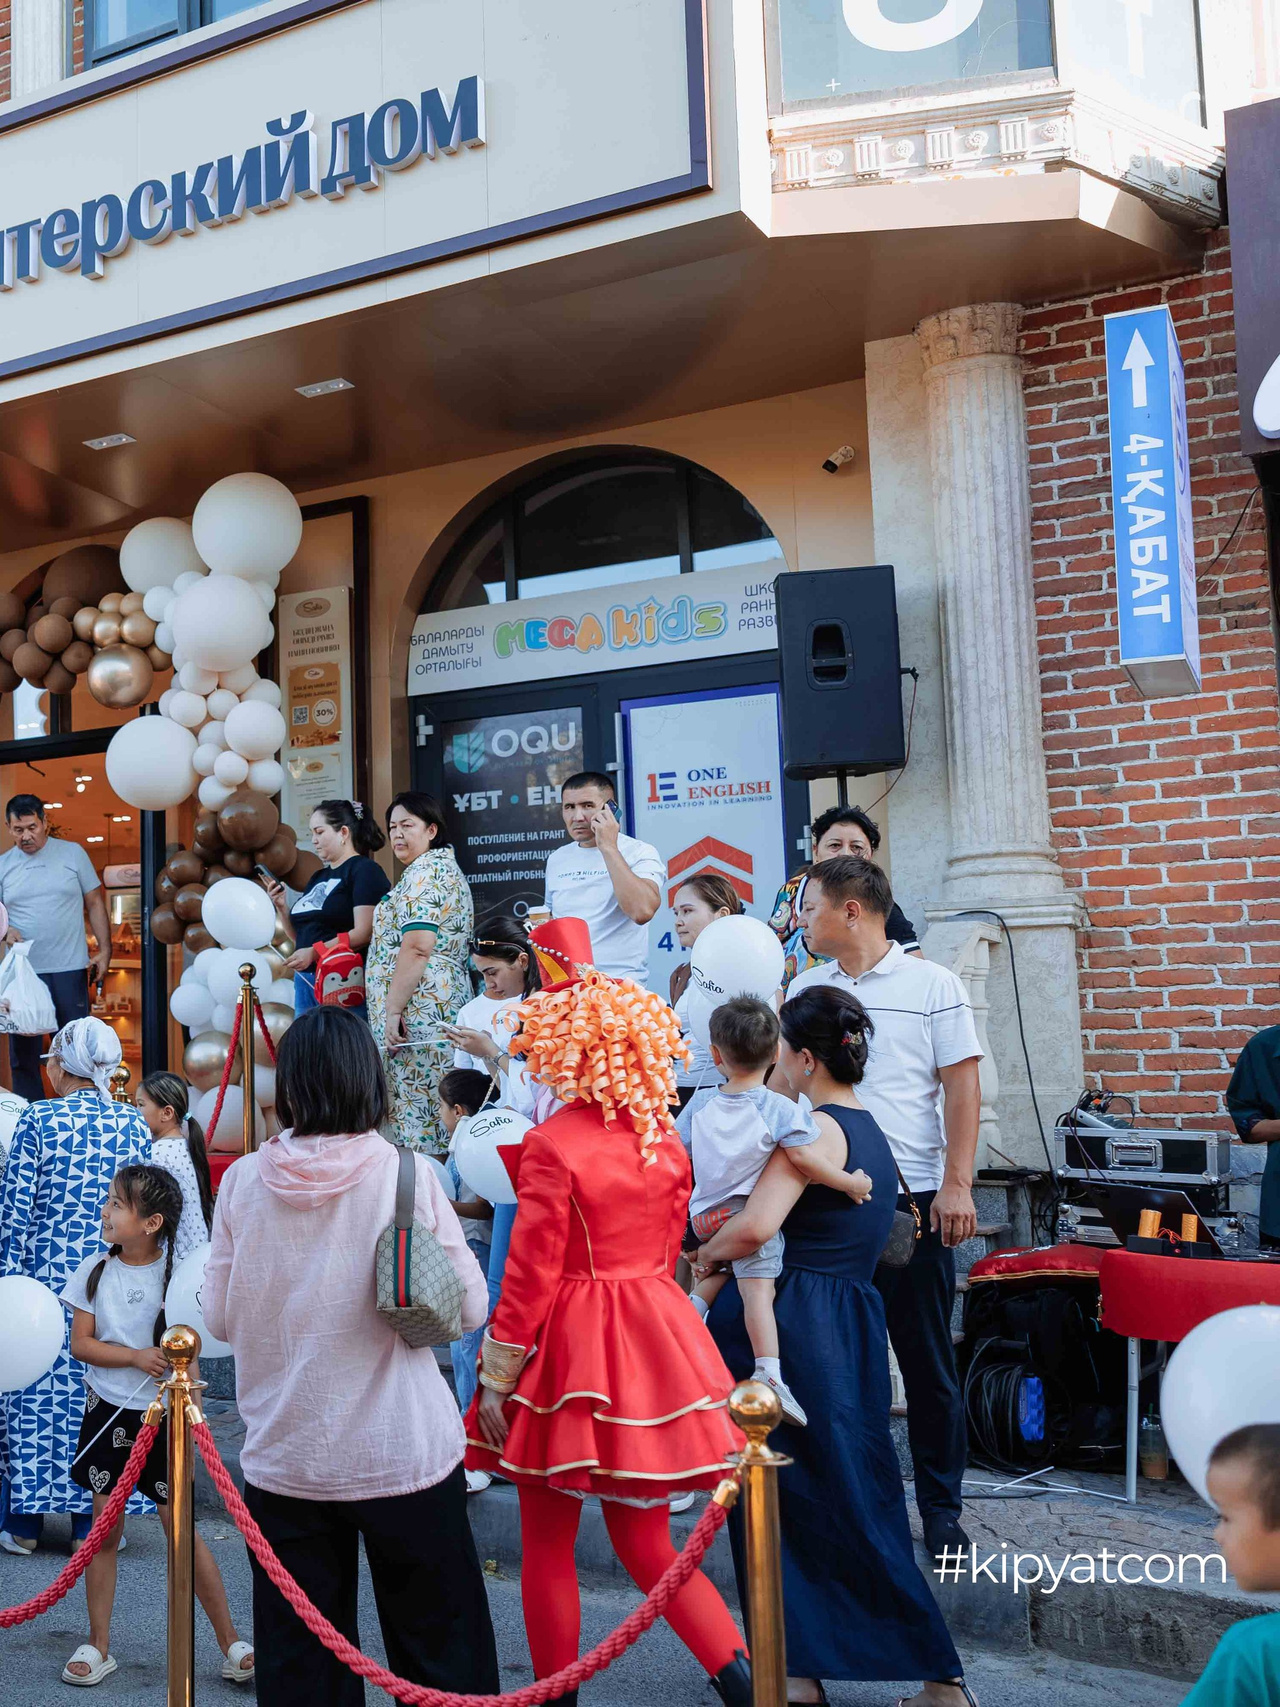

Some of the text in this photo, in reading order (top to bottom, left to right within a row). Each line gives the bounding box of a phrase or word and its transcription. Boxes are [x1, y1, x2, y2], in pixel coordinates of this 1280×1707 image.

[320, 75, 486, 200] дом
[1121, 433, 1171, 623] 4-ҚАБАТ
[738, 615, 777, 631] РАЗВ
[410, 625, 484, 646] БАЛАЛАРДЫ
[422, 642, 474, 659] ДАМЫТУ
[415, 657, 482, 675] ОРТАЛЫҒЫ
[316, 709, 334, 717] 30%
[491, 722, 576, 758] OQU
[687, 767, 727, 782] ONE
[688, 781, 772, 799] ENGLISH
[453, 790, 503, 813] ҰБТ
[647, 801, 705, 811] INNOVATION
[723, 795, 773, 805] LEARNING
[467, 829, 566, 846] ПОСТУПЛЕНИЕ НА ГРАНТ
[691, 965, 725, 994] Safia
[469, 1115, 513, 1138] Safia
